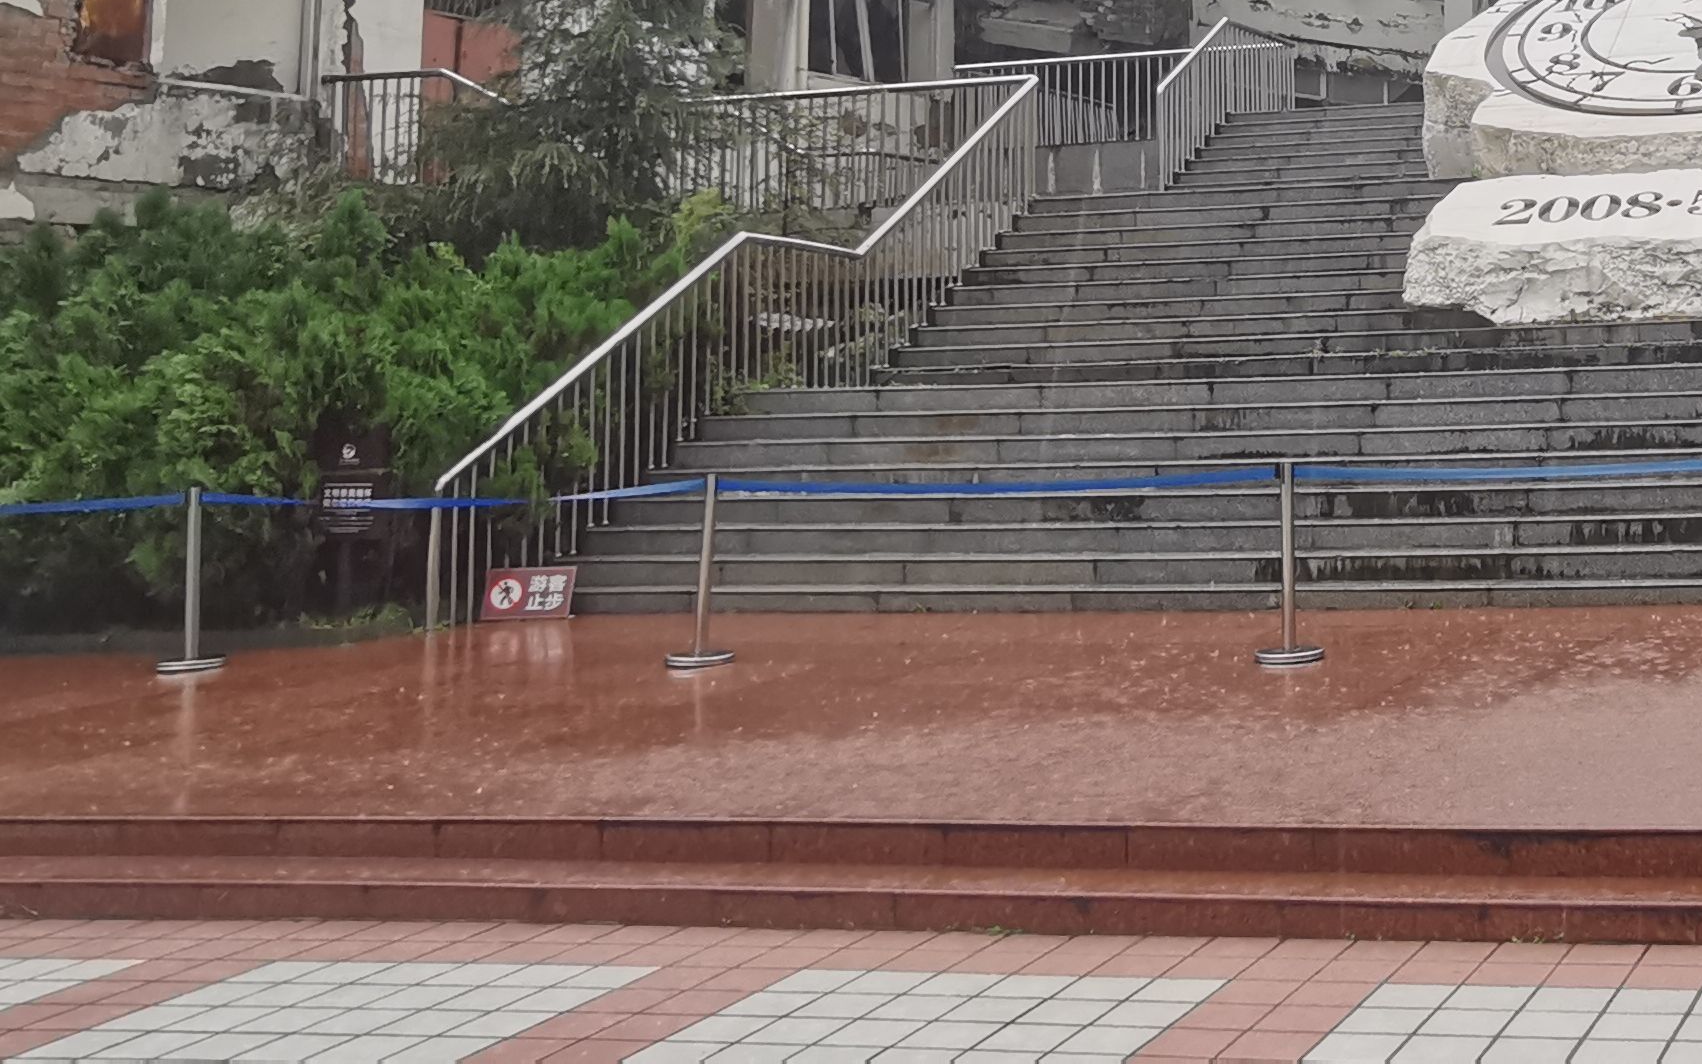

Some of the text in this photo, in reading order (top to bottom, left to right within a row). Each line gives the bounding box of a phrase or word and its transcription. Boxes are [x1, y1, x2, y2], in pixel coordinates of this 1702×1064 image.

[1537, 21, 1575, 42] 9
[1546, 53, 1581, 73] 8
[1588, 69, 1626, 93] 7
[527, 574, 568, 593] 游客
[524, 593, 565, 611] 止步
